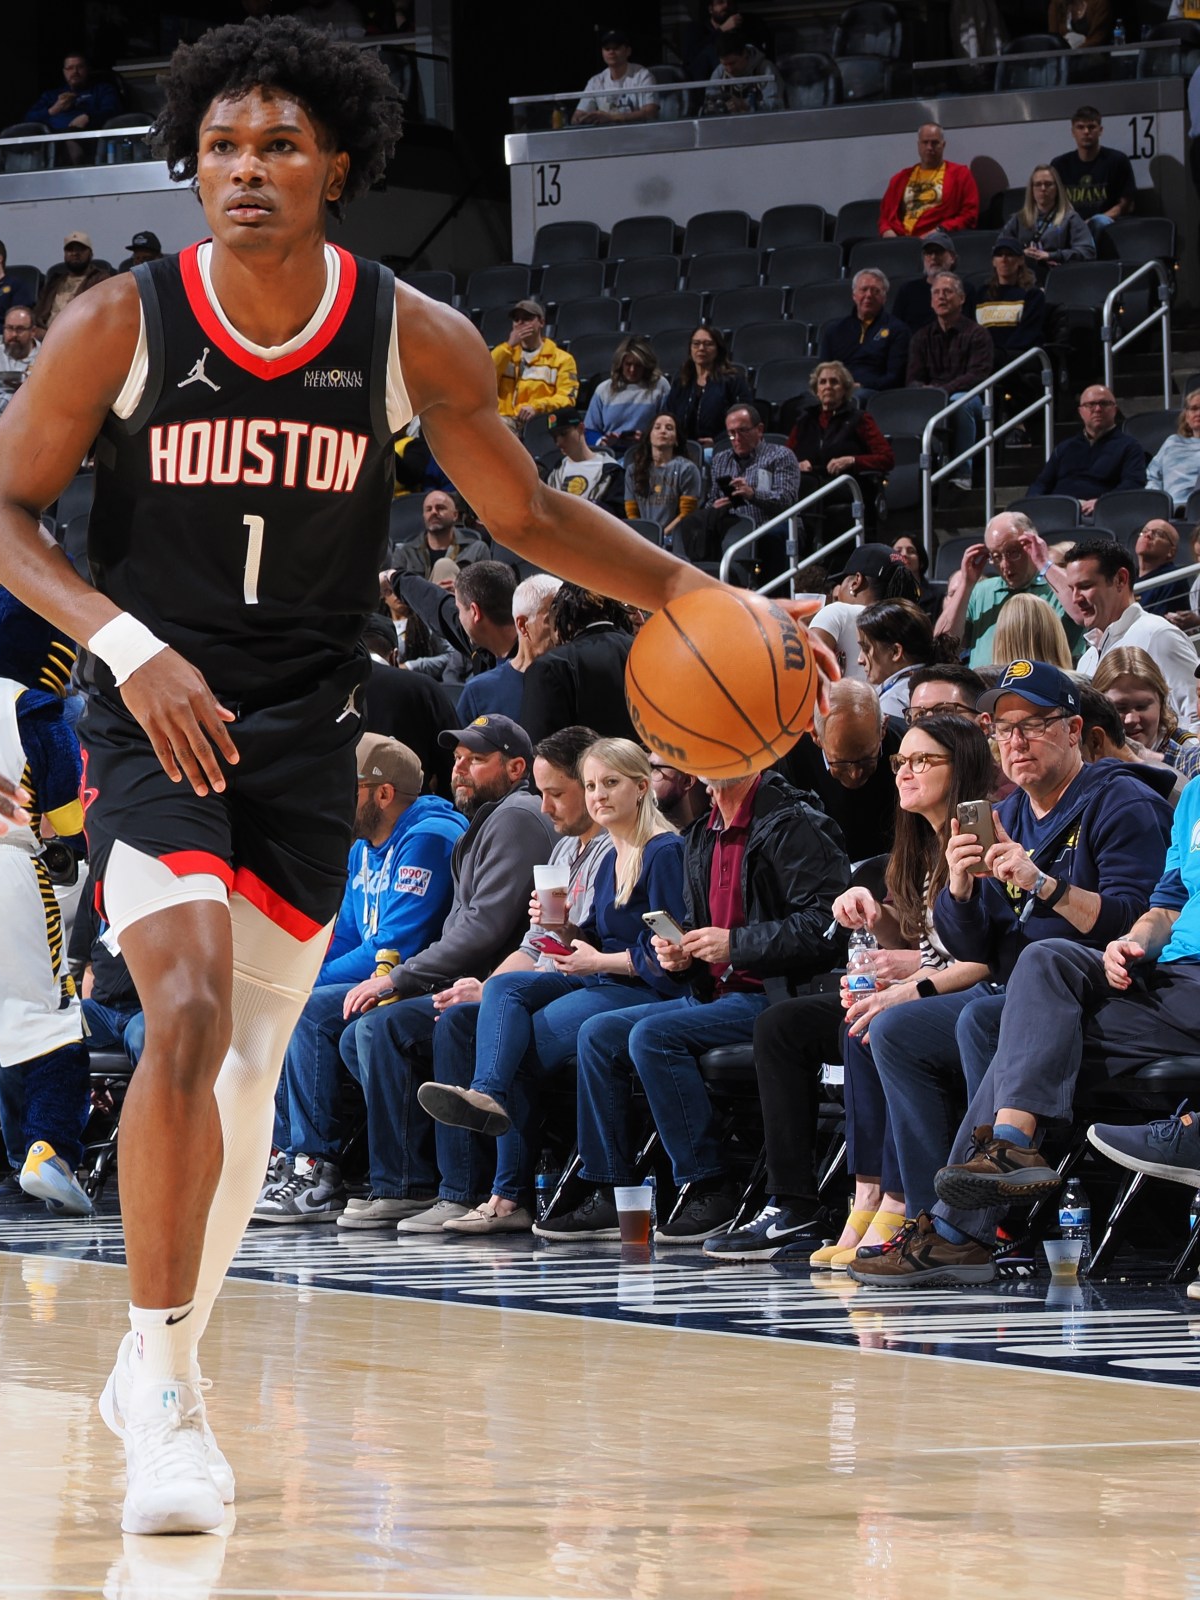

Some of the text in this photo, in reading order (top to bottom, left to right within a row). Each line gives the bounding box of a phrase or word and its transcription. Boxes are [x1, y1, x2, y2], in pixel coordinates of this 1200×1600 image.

[1128, 115, 1155, 160] 13
[537, 164, 561, 207] 13
[1066, 186, 1108, 203] NDIANA
[304, 378, 363, 388] HERMANN
[305, 369, 363, 381] MEMORIAL
[150, 417, 369, 492] HOUSTON
[243, 514, 265, 604] 1
[400, 868, 422, 879] 1990
